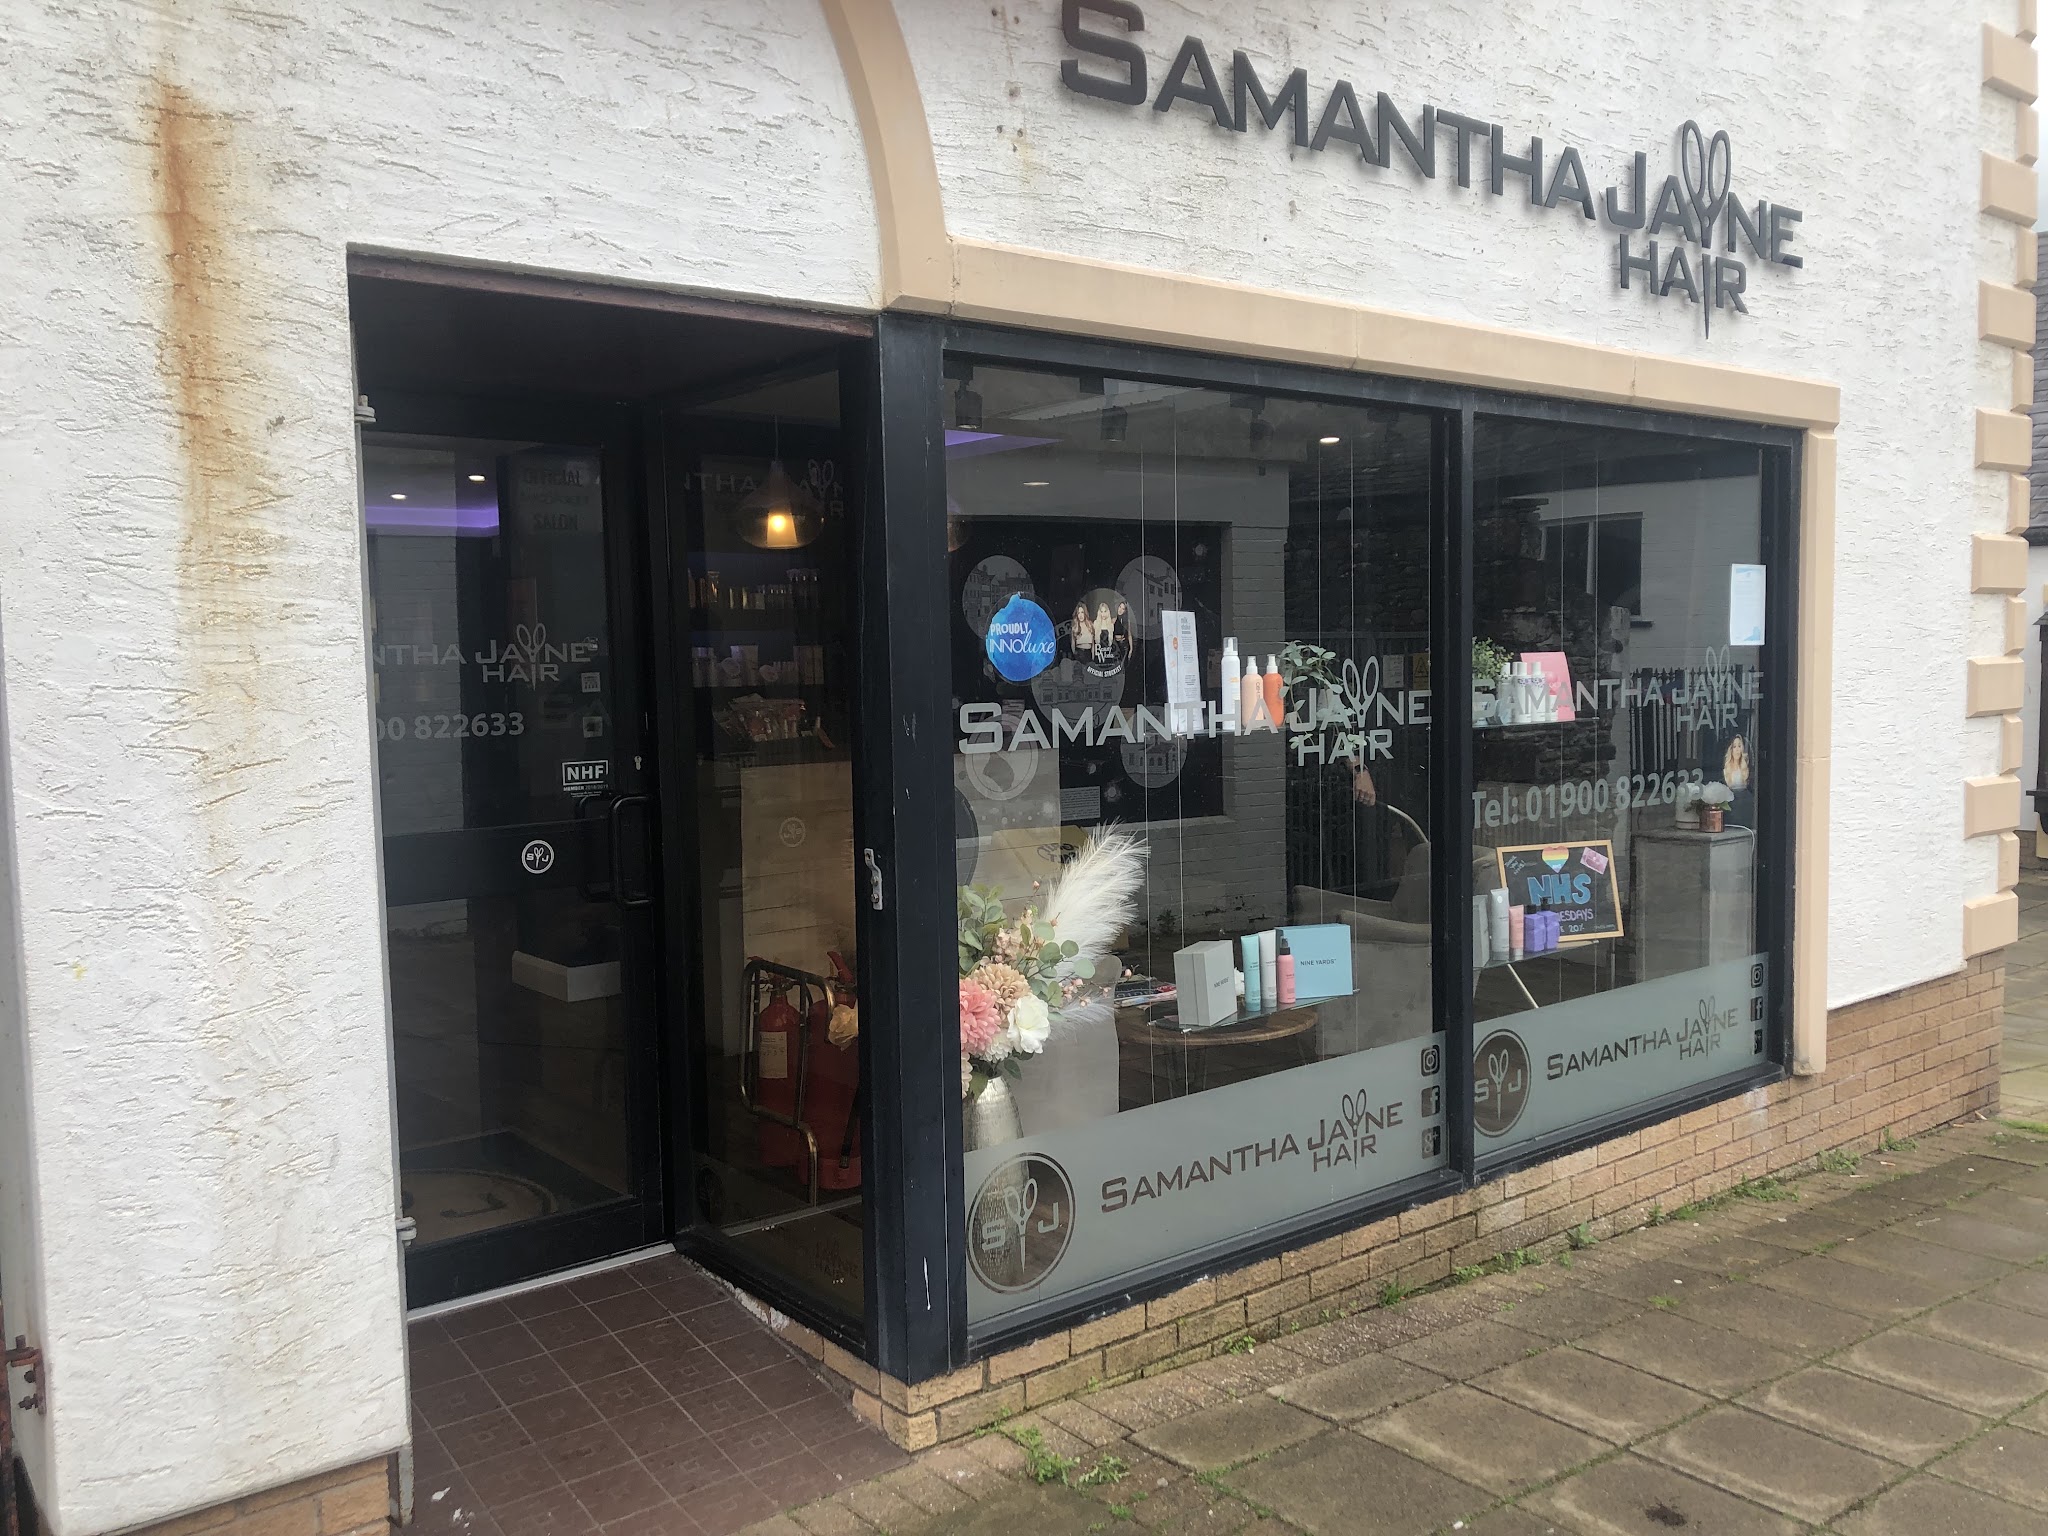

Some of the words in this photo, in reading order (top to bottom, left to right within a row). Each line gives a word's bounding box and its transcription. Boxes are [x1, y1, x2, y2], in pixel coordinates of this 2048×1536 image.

[1061, 0, 1596, 220] SAMANTHA
[1606, 119, 1803, 269] JAYNE
[1618, 232, 1749, 338] HAIR
[476, 623, 591, 665] JAYNE
[990, 622, 1029, 636] PROUDLY
[483, 664, 560, 690] HAIR
[1472, 677, 1665, 718] SAMANTHA
[1671, 645, 1764, 704] JAYNE
[958, 702, 1279, 754] SAMANTHA
[1290, 656, 1432, 732] JAYNE
[1677, 703, 1739, 737] HAIR
[414, 712, 525, 740] 822633
[1297, 729, 1394, 769] HAIR
[567, 765, 604, 781] NHF
[1472, 786, 1518, 829] Tel:
[1526, 778, 1610, 822] 01900
[1614, 768, 1704, 810] 822633
[1527, 874, 1592, 905] NHS
[1558, 908, 1594, 922] ESDAYS
[1547, 1027, 1671, 1081] SAMANTHA
[1679, 1033, 1721, 1061] HAIR
[1100, 1132, 1301, 1213] SAMANTHA
[1306, 1088, 1403, 1151] JAYNE
[1312, 1134, 1378, 1172] HAIR
